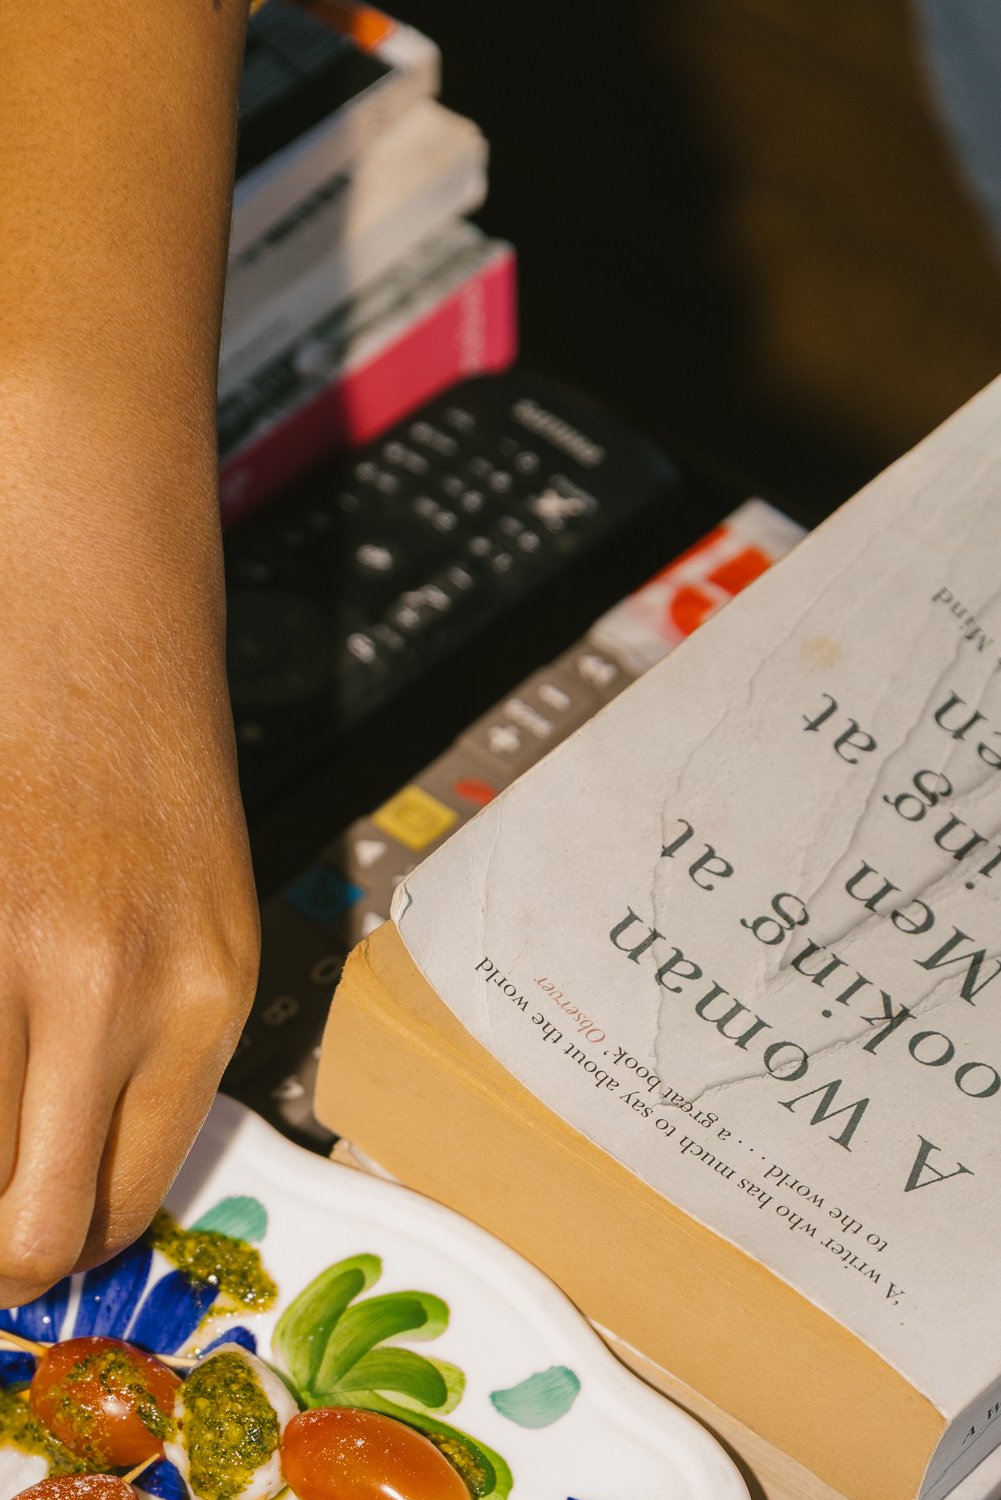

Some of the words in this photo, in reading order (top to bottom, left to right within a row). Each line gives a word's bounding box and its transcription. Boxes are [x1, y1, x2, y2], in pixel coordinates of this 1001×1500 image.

[931, 586, 994, 653] Mind
[802, 693, 878, 765] at
[660, 818, 735, 892] at
[844, 859, 1001, 1007] Men
[474, 956, 529, 1013] world
[531, 1012, 563, 1044] the
[536, 977, 606, 1043] Observer
[609, 905, 871, 1153] Woman
[563, 1042, 620, 1092] about
[619, 1091, 654, 1118] say
[661, 1086, 719, 1129] great
[655, 1118, 677, 1138] to
[716, 1127, 732, 1141] a
[679, 1135, 737, 1180] much
[903, 1134, 975, 1193] A
[736, 1178, 774, 1210] has
[762, 1164, 825, 1209] world
[775, 1205, 817, 1238] who
[828, 1207, 863, 1235] the
[866, 1233, 888, 1253] to
[819, 1237, 881, 1285] writer
